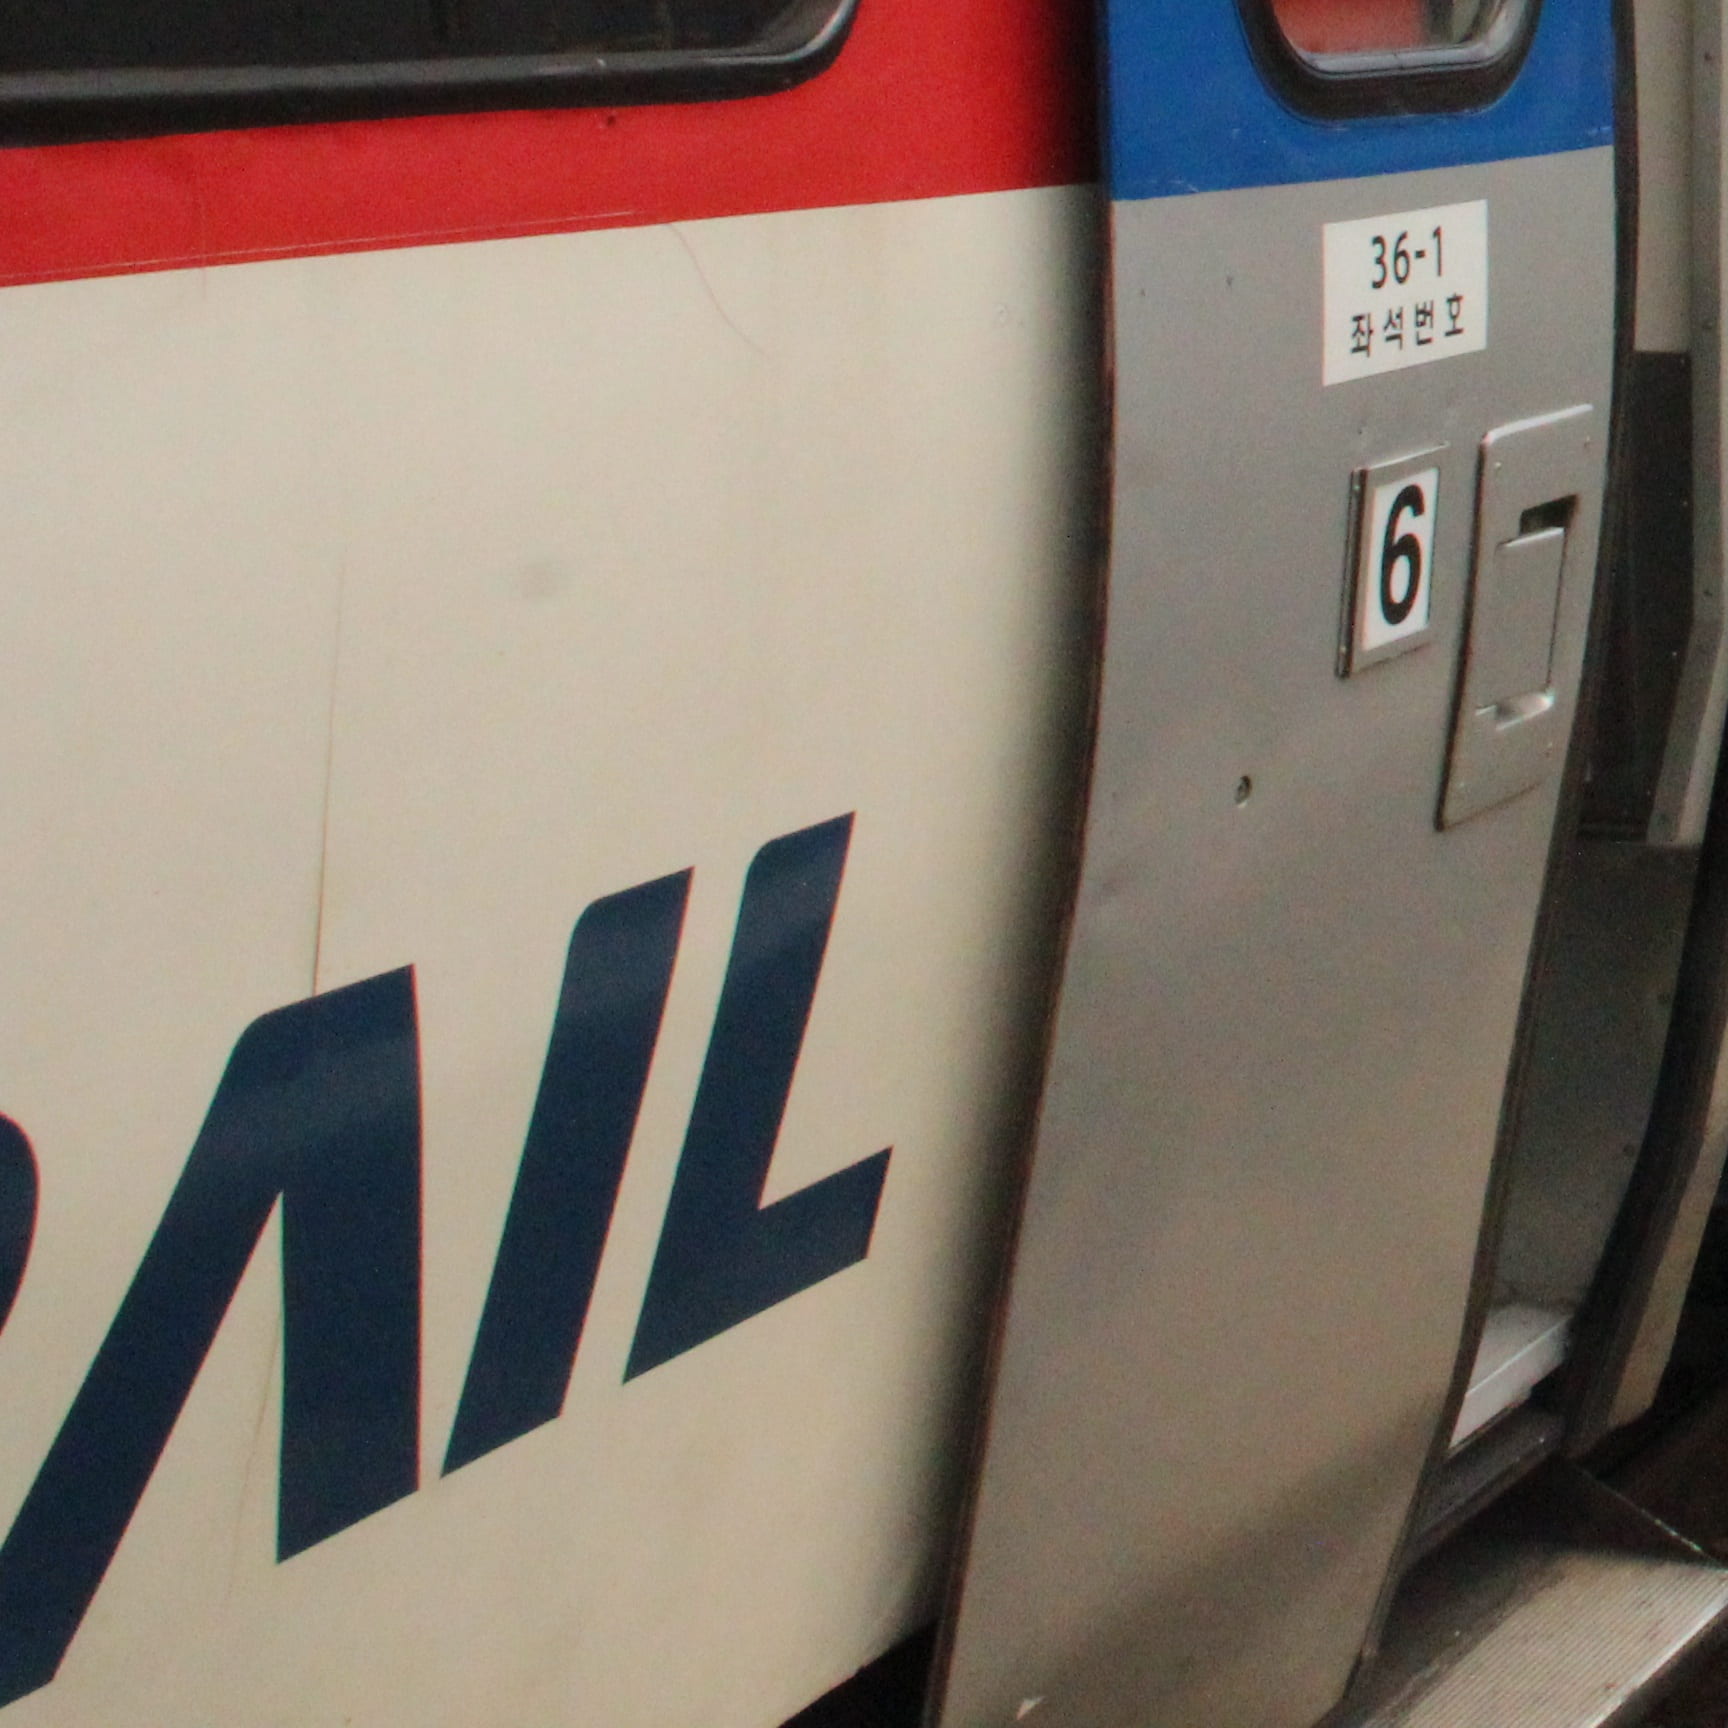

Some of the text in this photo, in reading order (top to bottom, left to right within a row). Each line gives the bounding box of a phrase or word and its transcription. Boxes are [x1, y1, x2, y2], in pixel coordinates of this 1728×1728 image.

[1371, 225, 1443, 290] 36-1
[1351, 292, 1464, 358] 좌석번호
[1379, 482, 1426, 627] 6
[0, 810, 893, 1710] AIL
